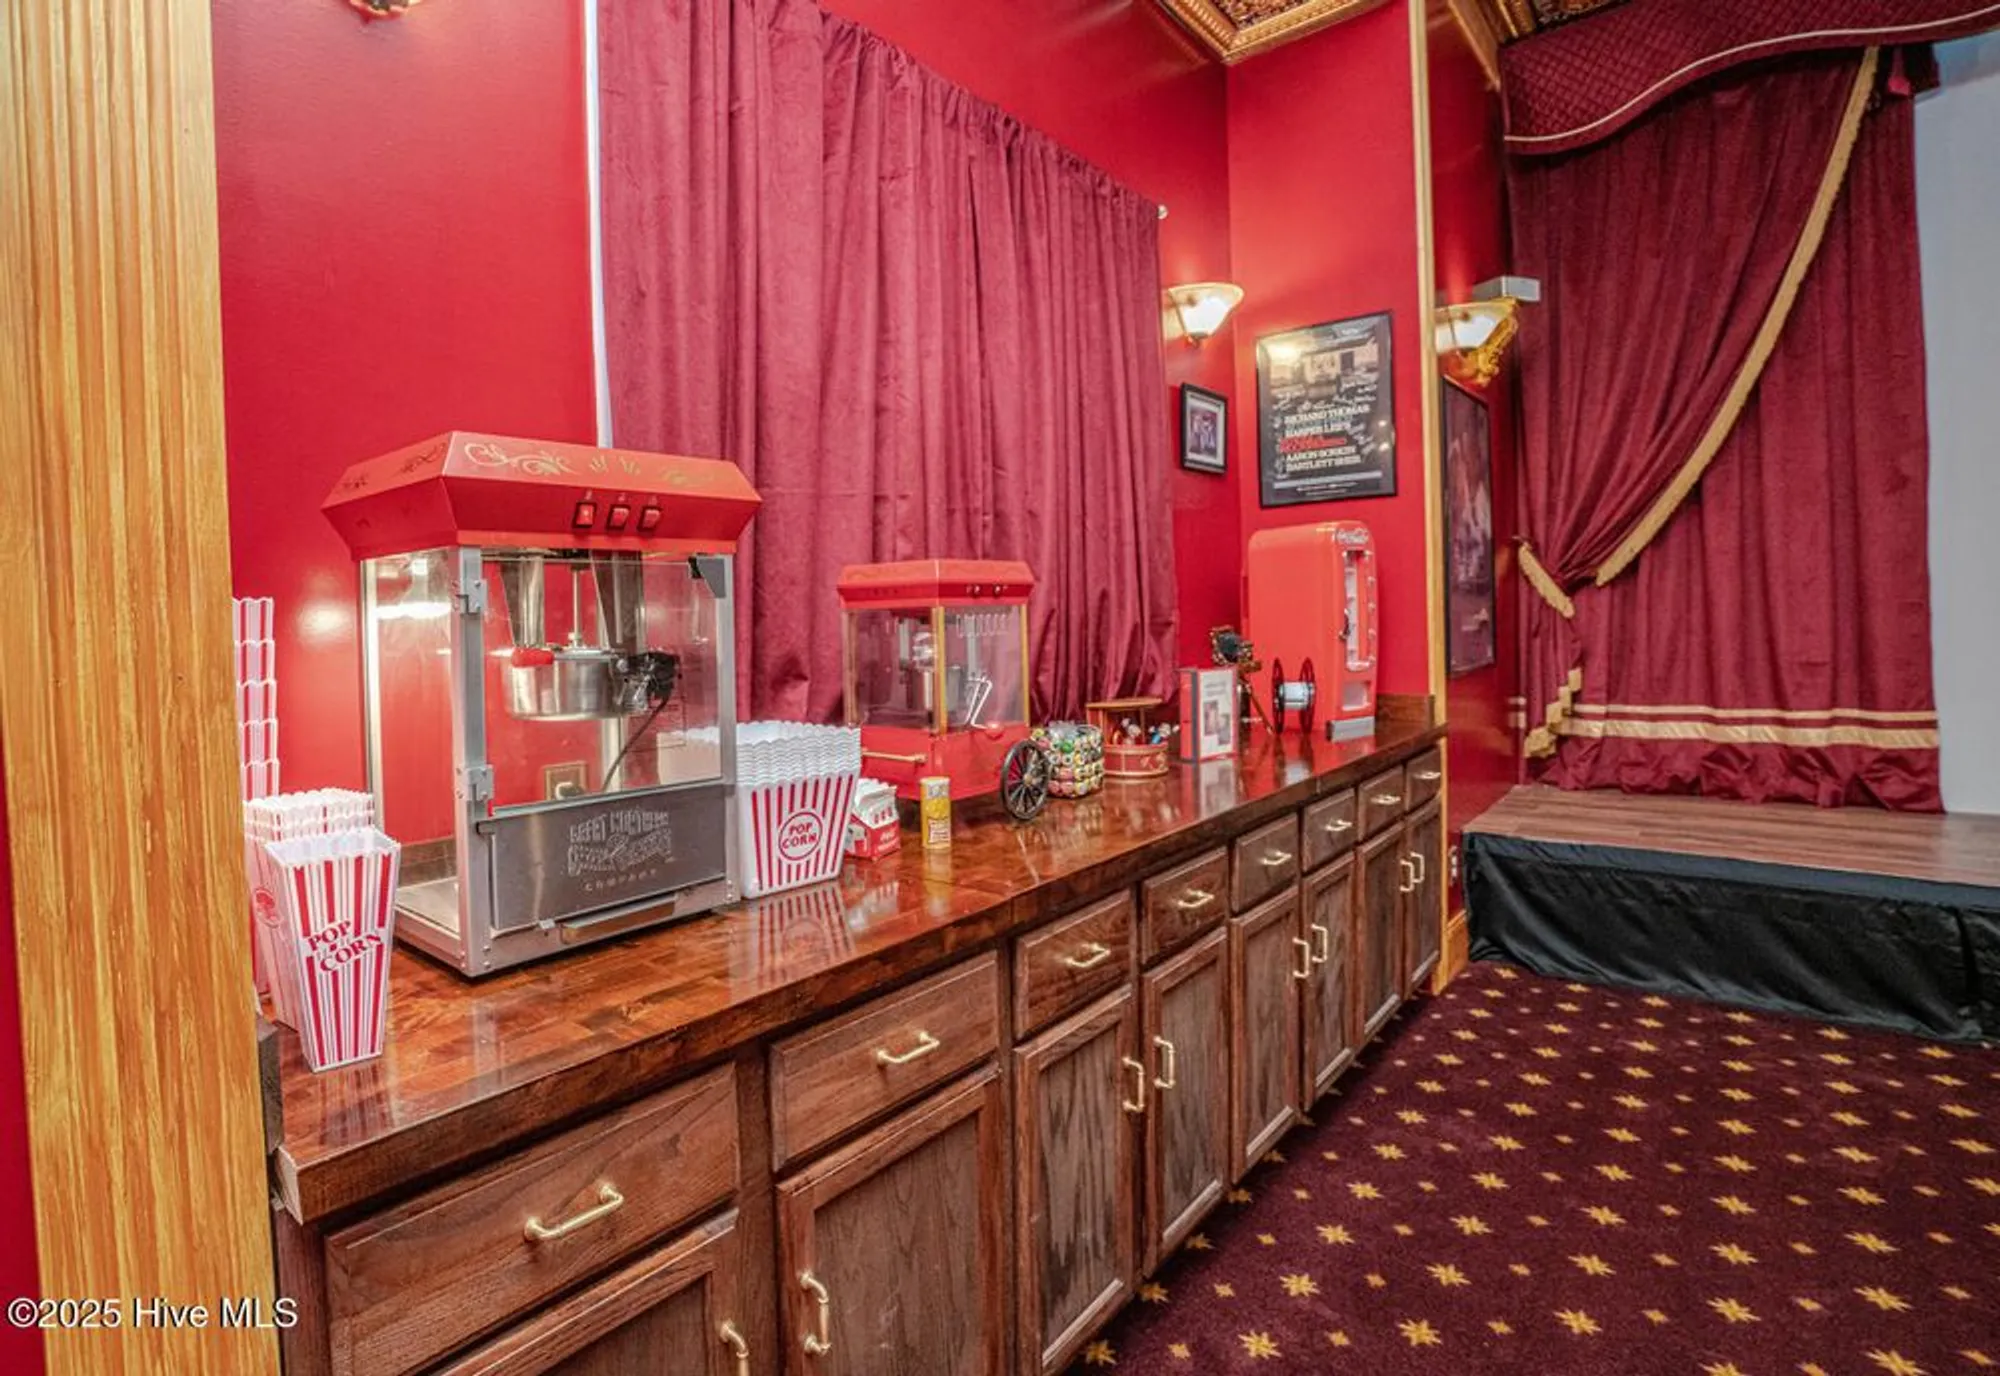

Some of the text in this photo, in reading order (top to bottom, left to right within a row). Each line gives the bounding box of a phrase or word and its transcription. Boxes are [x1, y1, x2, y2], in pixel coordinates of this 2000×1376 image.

[789, 821, 813, 836] POP
[782, 832, 818, 850] CORN
[308, 920, 351, 951] POP
[320, 934, 381, 971] CORN
